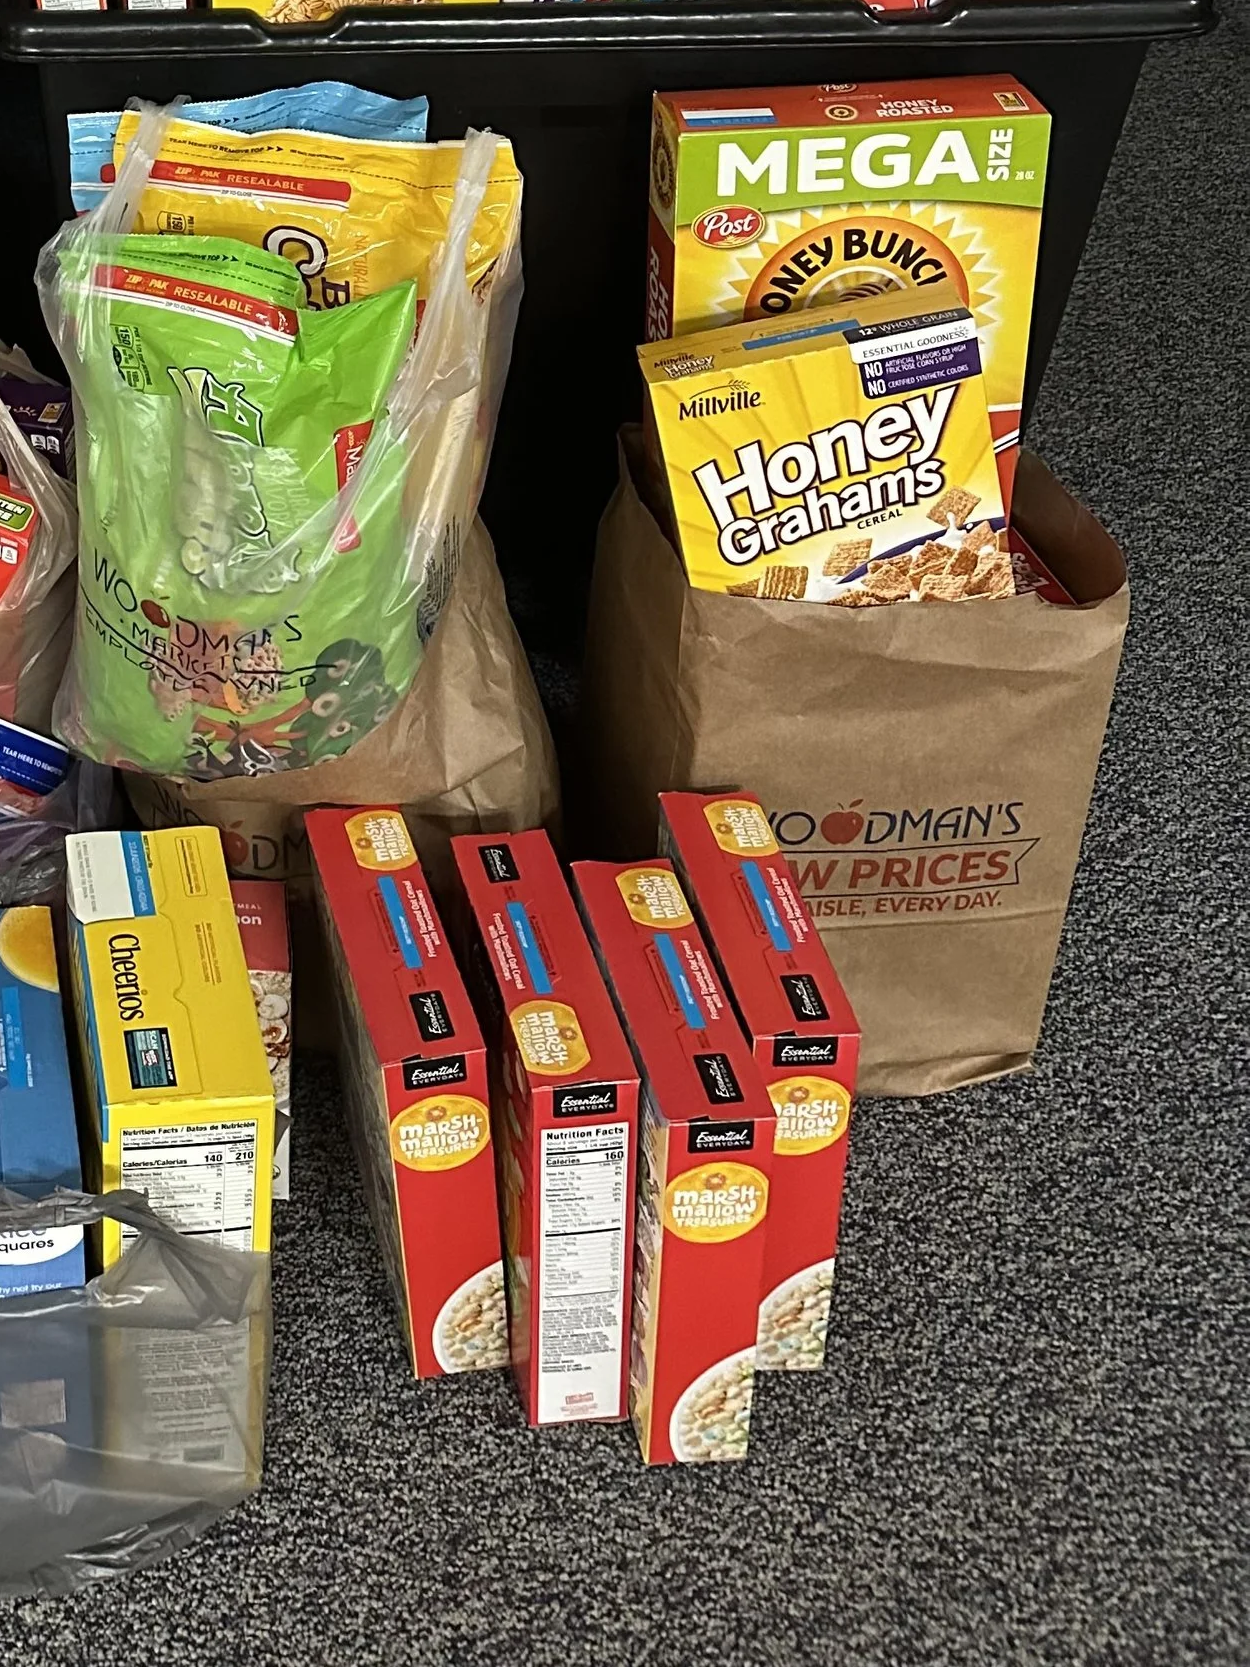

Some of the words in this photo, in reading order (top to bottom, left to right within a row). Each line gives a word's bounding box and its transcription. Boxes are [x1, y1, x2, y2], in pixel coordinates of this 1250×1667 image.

[716, 130, 980, 197] MEGA
[987, 128, 1013, 181] SIZE
[703, 211, 755, 240] Post
[173, 286, 253, 316] RESEALABLE
[678, 388, 761, 420] Millville
[696, 386, 957, 526] Honey
[718, 460, 944, 562] Grahams
[849, 849, 1011, 889] PRICES
[874, 894, 948, 915] EVERY
[953, 890, 1002, 912] DAY.
[546, 1129, 585, 1141] Nutrition
[589, 1126, 624, 1137] Facts
